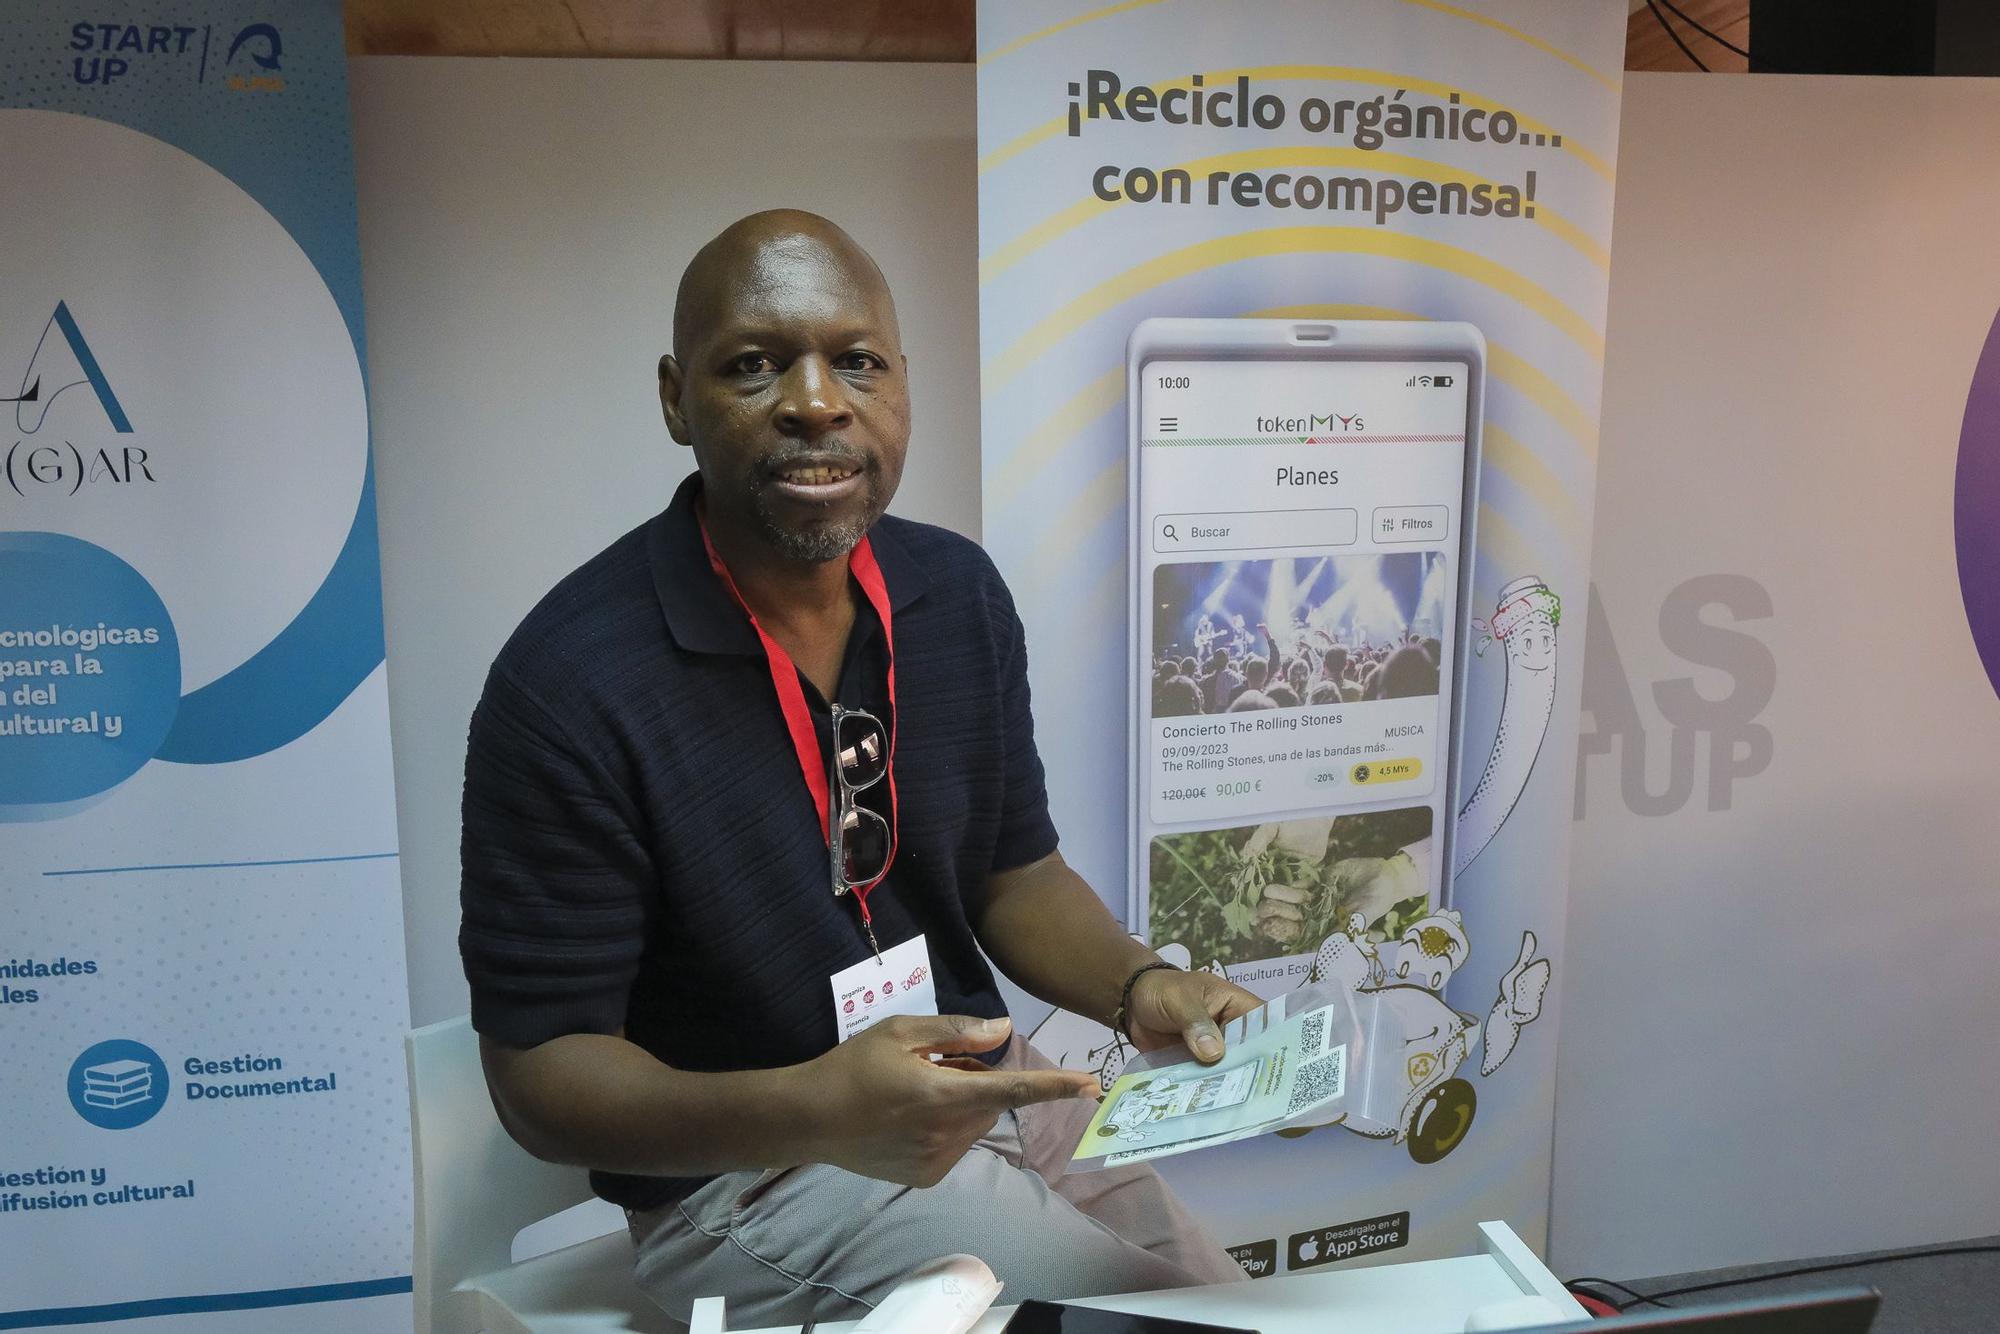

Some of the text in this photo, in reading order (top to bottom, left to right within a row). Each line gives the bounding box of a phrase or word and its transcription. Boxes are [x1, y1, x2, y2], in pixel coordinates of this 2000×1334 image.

[70, 22, 196, 53] START
[74, 57, 129, 85] UP
[1067, 69, 1562, 151] ¡Reciclo orgánico...
[1092, 164, 1537, 225] con recompensa!
[1158, 376, 1190, 389] 10:00
[0, 440, 158, 497] (G)AR
[1276, 466, 1339, 486] Planes
[1191, 526, 1230, 539] Buscar
[1402, 518, 1433, 530] Filtros
[0, 653, 103, 682] para la
[13, 683, 57, 706] del
[0, 711, 123, 738] ultural y
[1162, 713, 1343, 739] Concierto The Rolling Stones
[1384, 725, 1424, 738] MUSICA
[1162, 743, 1229, 759] 09/09/2023
[1163, 742, 1394, 773] The Rolling Stones, una de las bandas más...
[1314, 773, 1334, 783] -20%
[1379, 764, 1409, 777] 4,5 MYs
[1216, 781, 1250, 796] 90,00
[1255, 779, 1263, 792] €
[0, 985, 40, 1003] les
[841, 985, 866, 1001] Organiza
[845, 1014, 870, 1030] Financia
[184, 1053, 282, 1076] Gestión
[186, 1072, 337, 1101] Documental
[91, 1168, 106, 1186] y
[0, 1179, 195, 1213] ifusión cultural
[1325, 1217, 1400, 1241] Descárgalo en el
[1240, 1248, 1252, 1258] EN
[1326, 1231, 1399, 1257] App Store
[1240, 1258, 1269, 1272] Play
